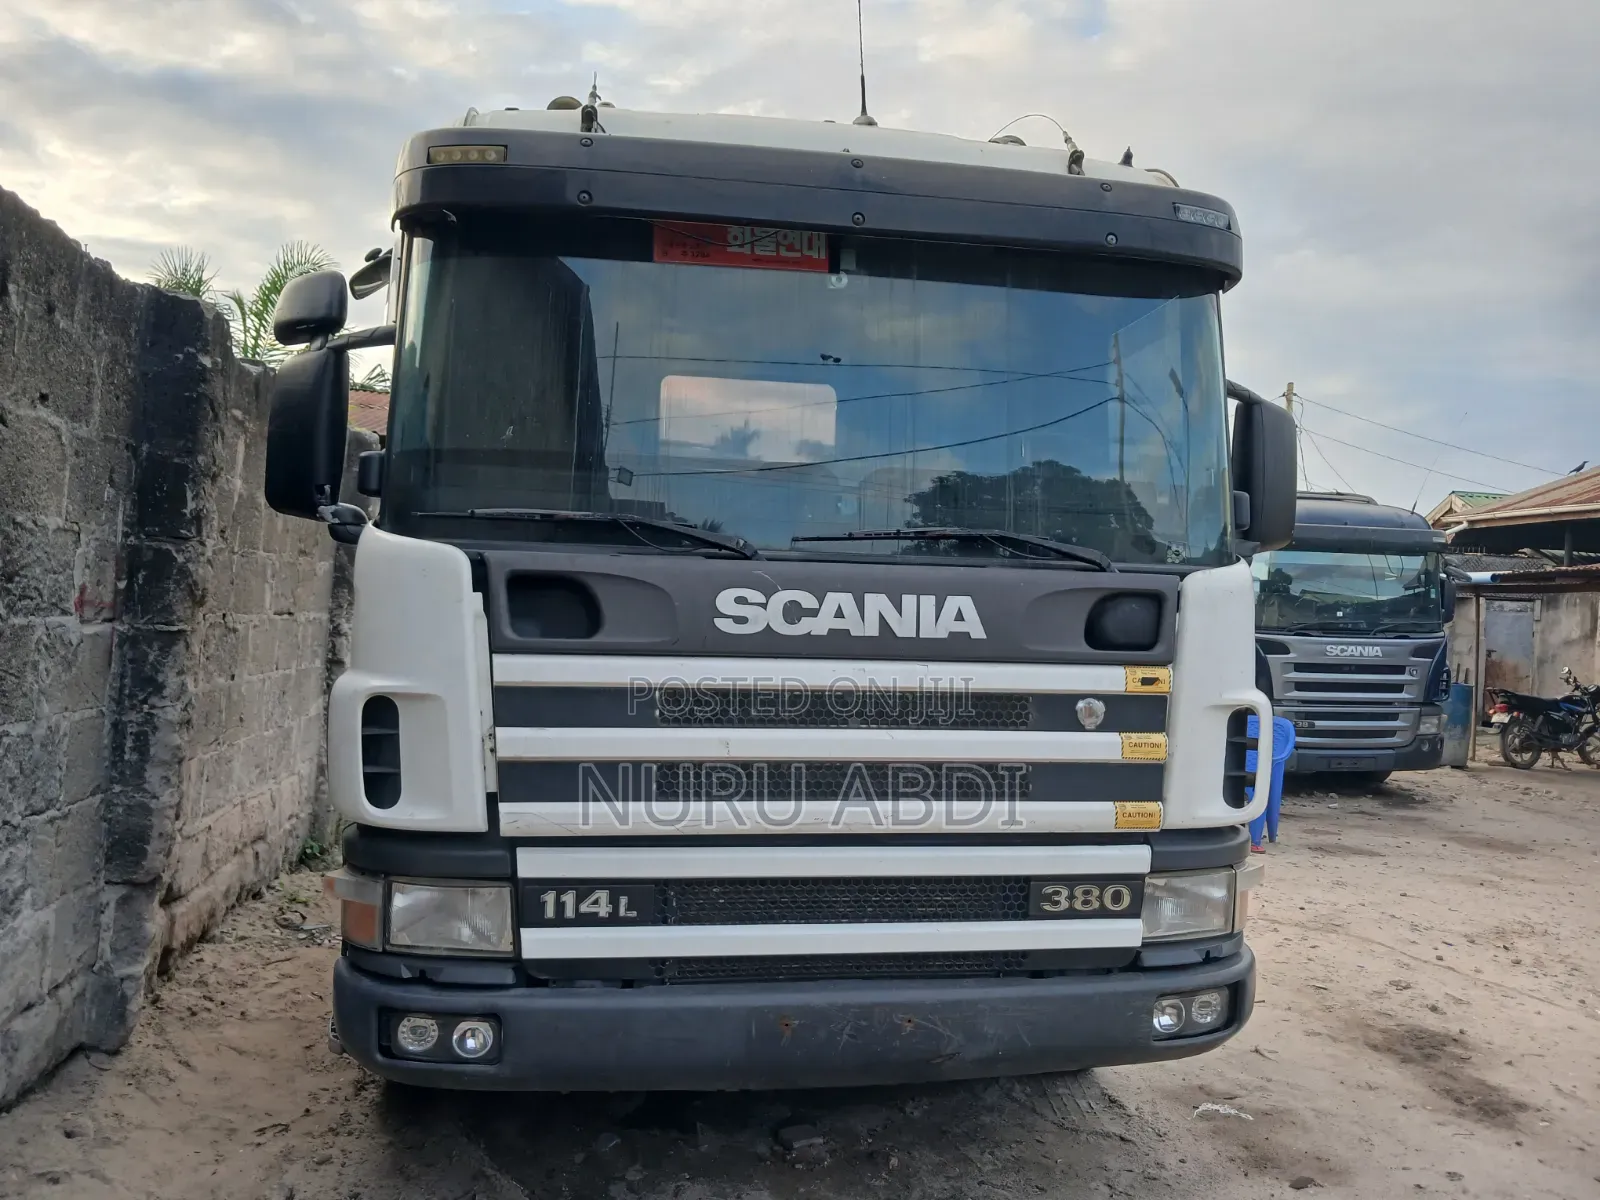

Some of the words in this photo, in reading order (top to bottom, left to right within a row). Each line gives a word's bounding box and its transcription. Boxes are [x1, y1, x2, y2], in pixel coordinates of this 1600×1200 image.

[713, 587, 987, 640] SCANIA
[1325, 644, 1383, 657] SCANIA
[1128, 741, 1162, 749] CAUTION!
[1122, 811, 1156, 819] CAUTION!
[1039, 884, 1133, 912] 380
